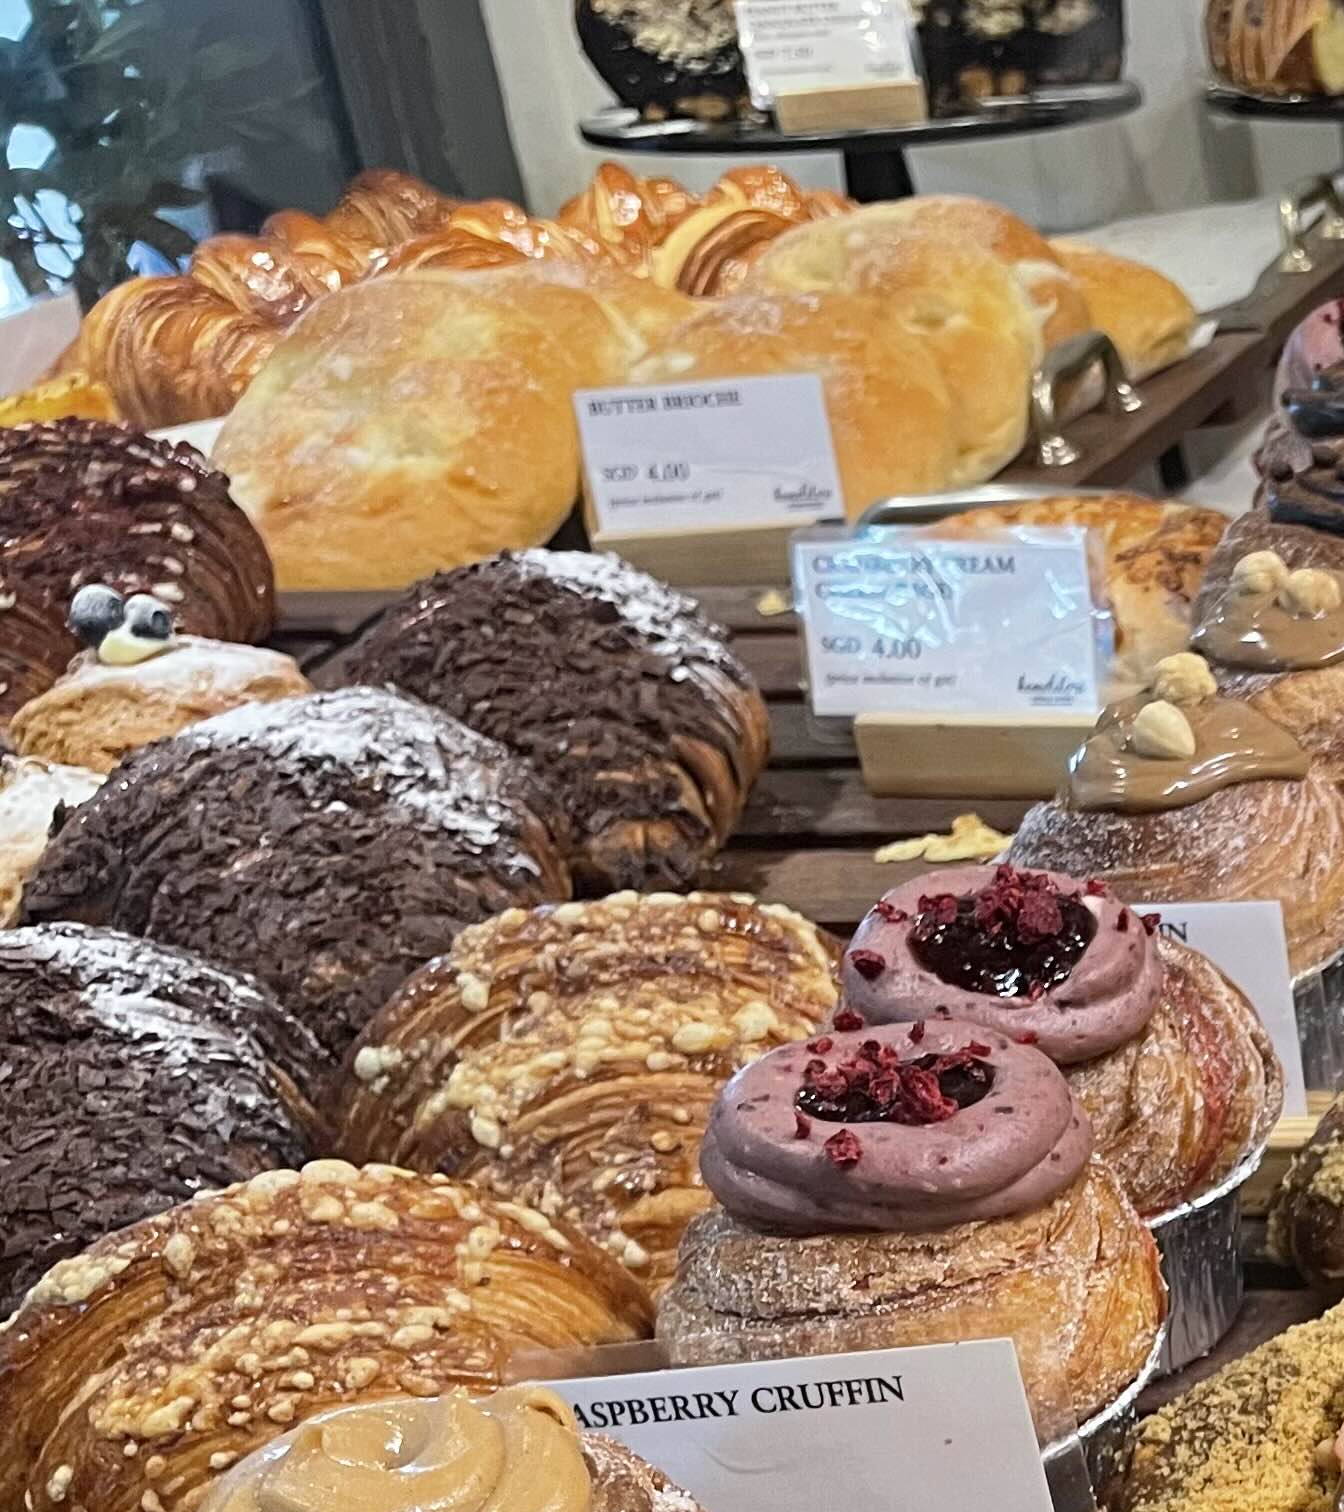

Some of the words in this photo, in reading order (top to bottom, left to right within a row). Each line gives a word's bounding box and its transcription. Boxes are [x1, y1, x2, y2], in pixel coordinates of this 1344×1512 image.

[950, 556, 1016, 574] REAM
[573, 1389, 740, 1430] ASPBERRY
[750, 1374, 904, 1413] CRUFFIN
